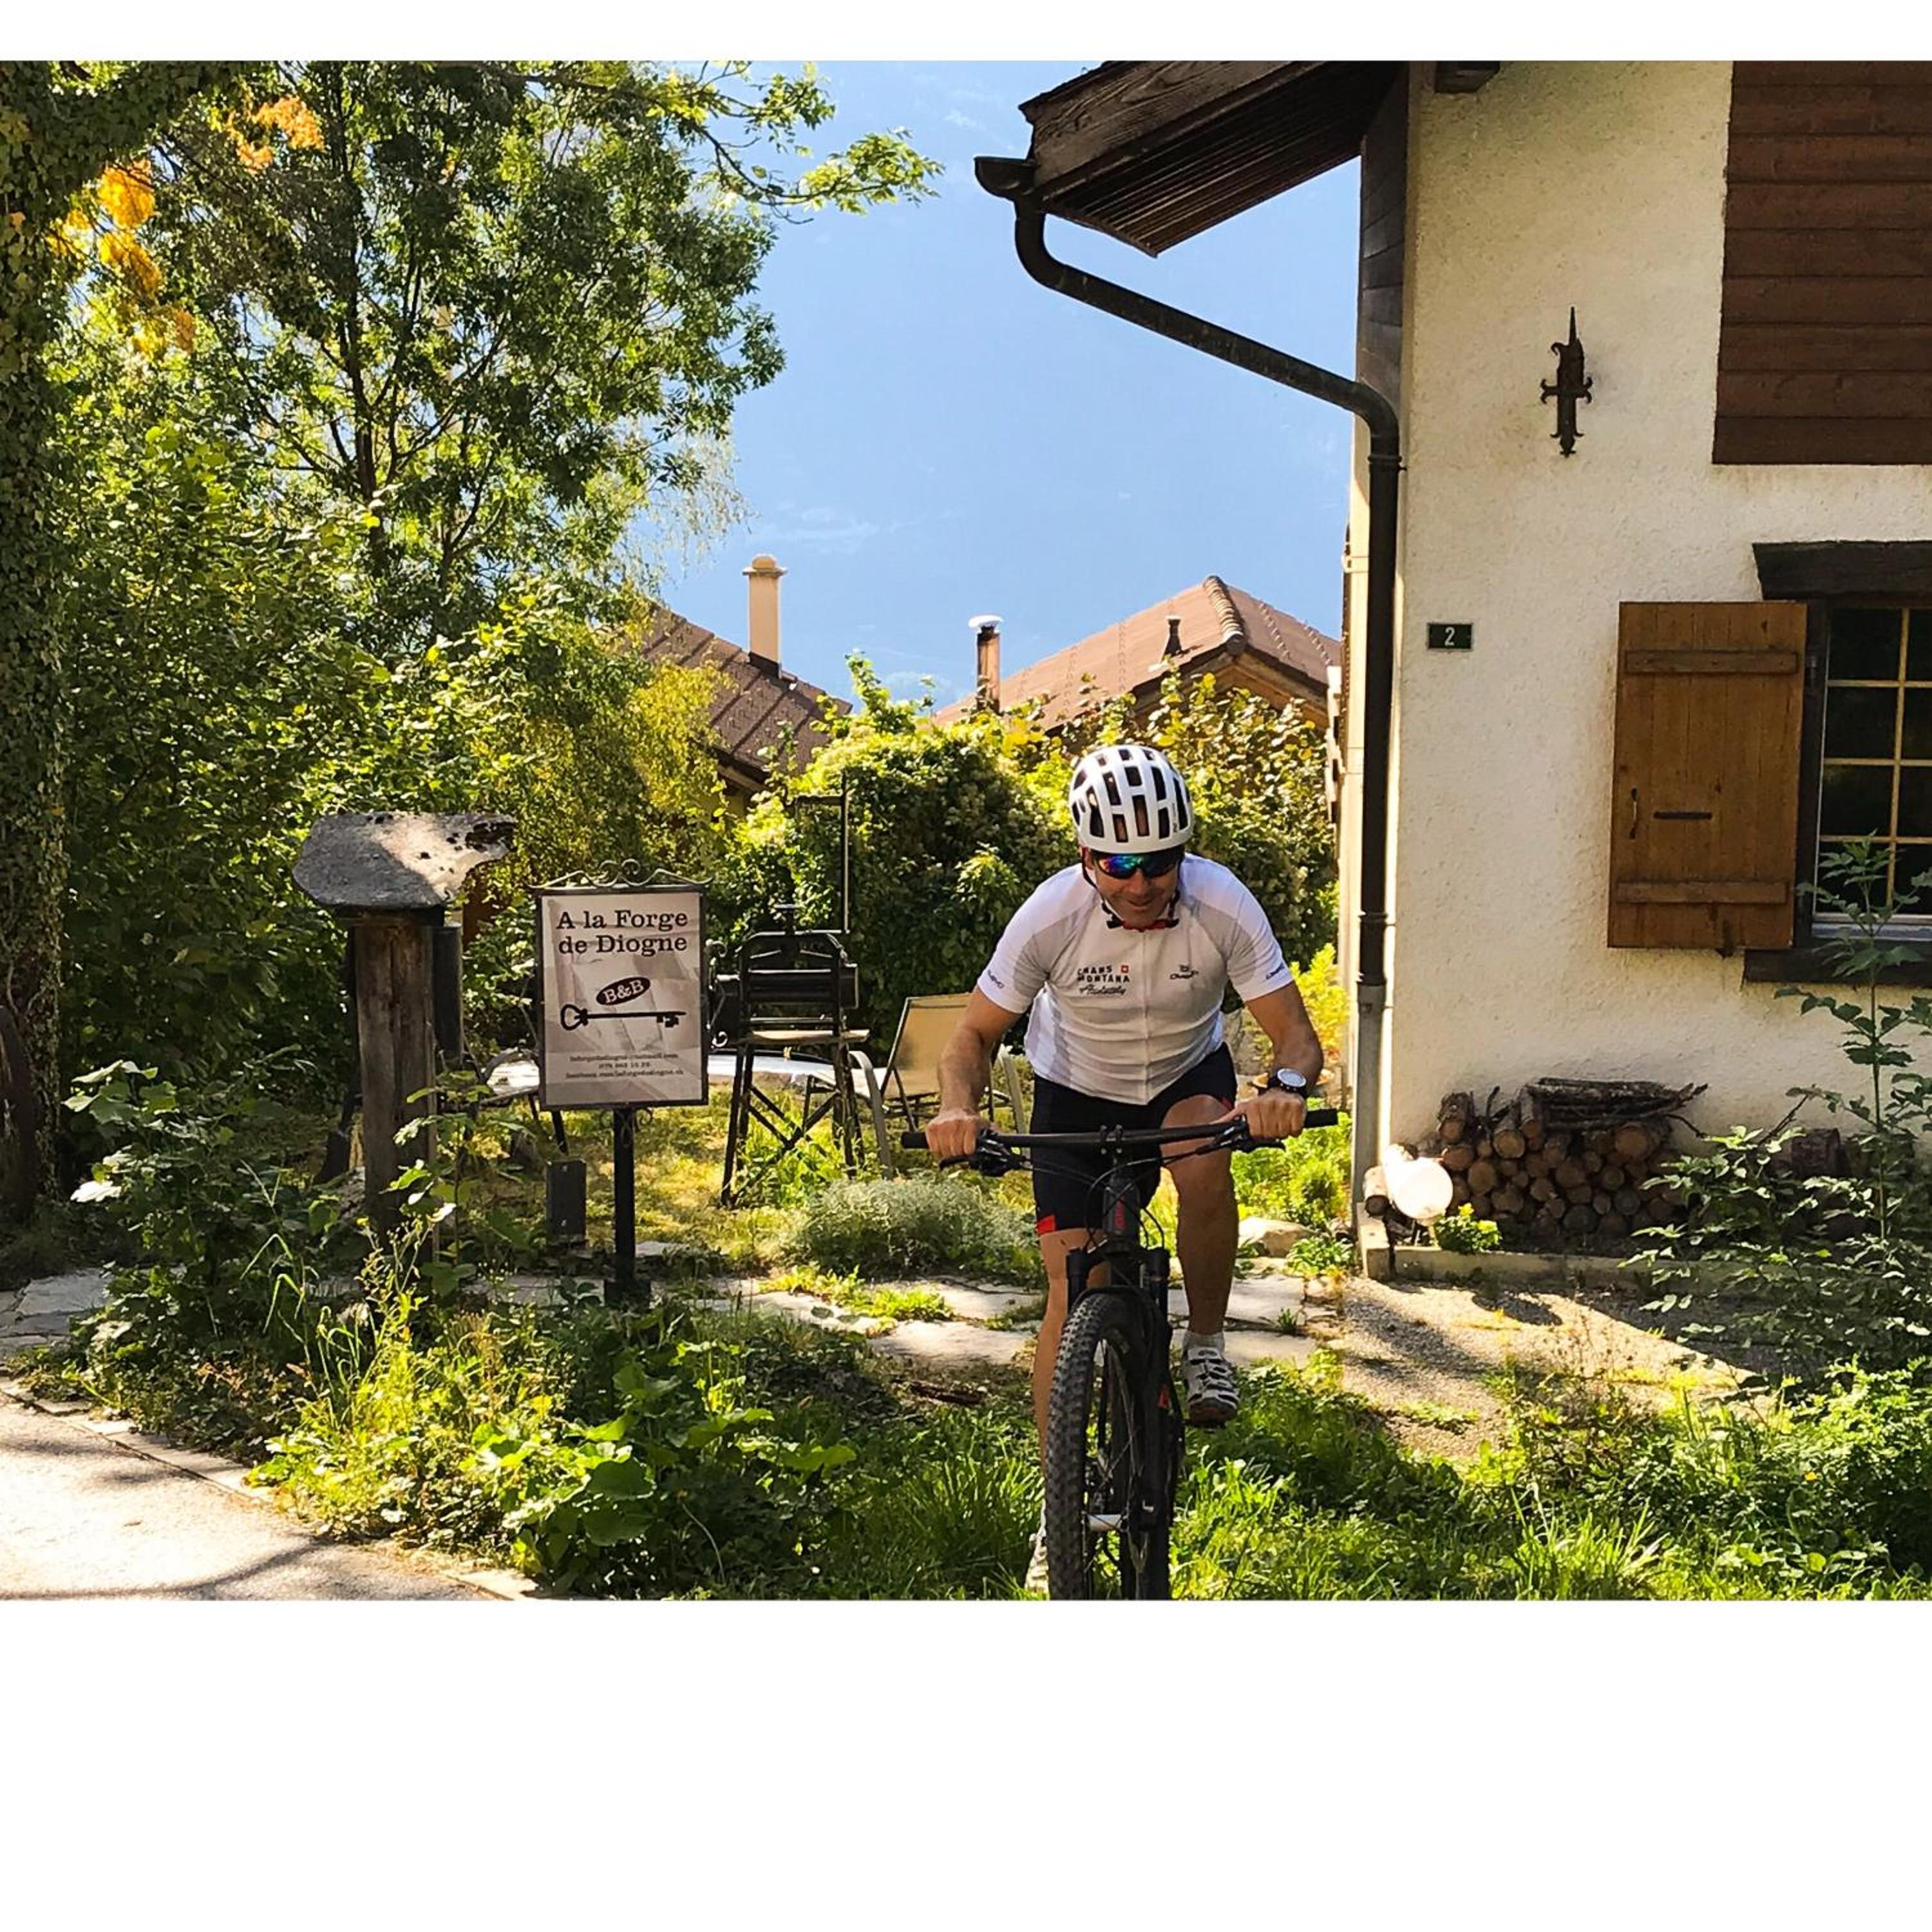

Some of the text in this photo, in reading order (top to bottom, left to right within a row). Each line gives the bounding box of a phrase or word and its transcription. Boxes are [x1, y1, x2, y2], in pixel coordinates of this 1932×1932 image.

[1444, 627, 1455, 647] 2
[556, 910, 688, 931] A la Forge
[558, 934, 687, 957] de Diogne
[603, 980, 644, 1003] B&B
